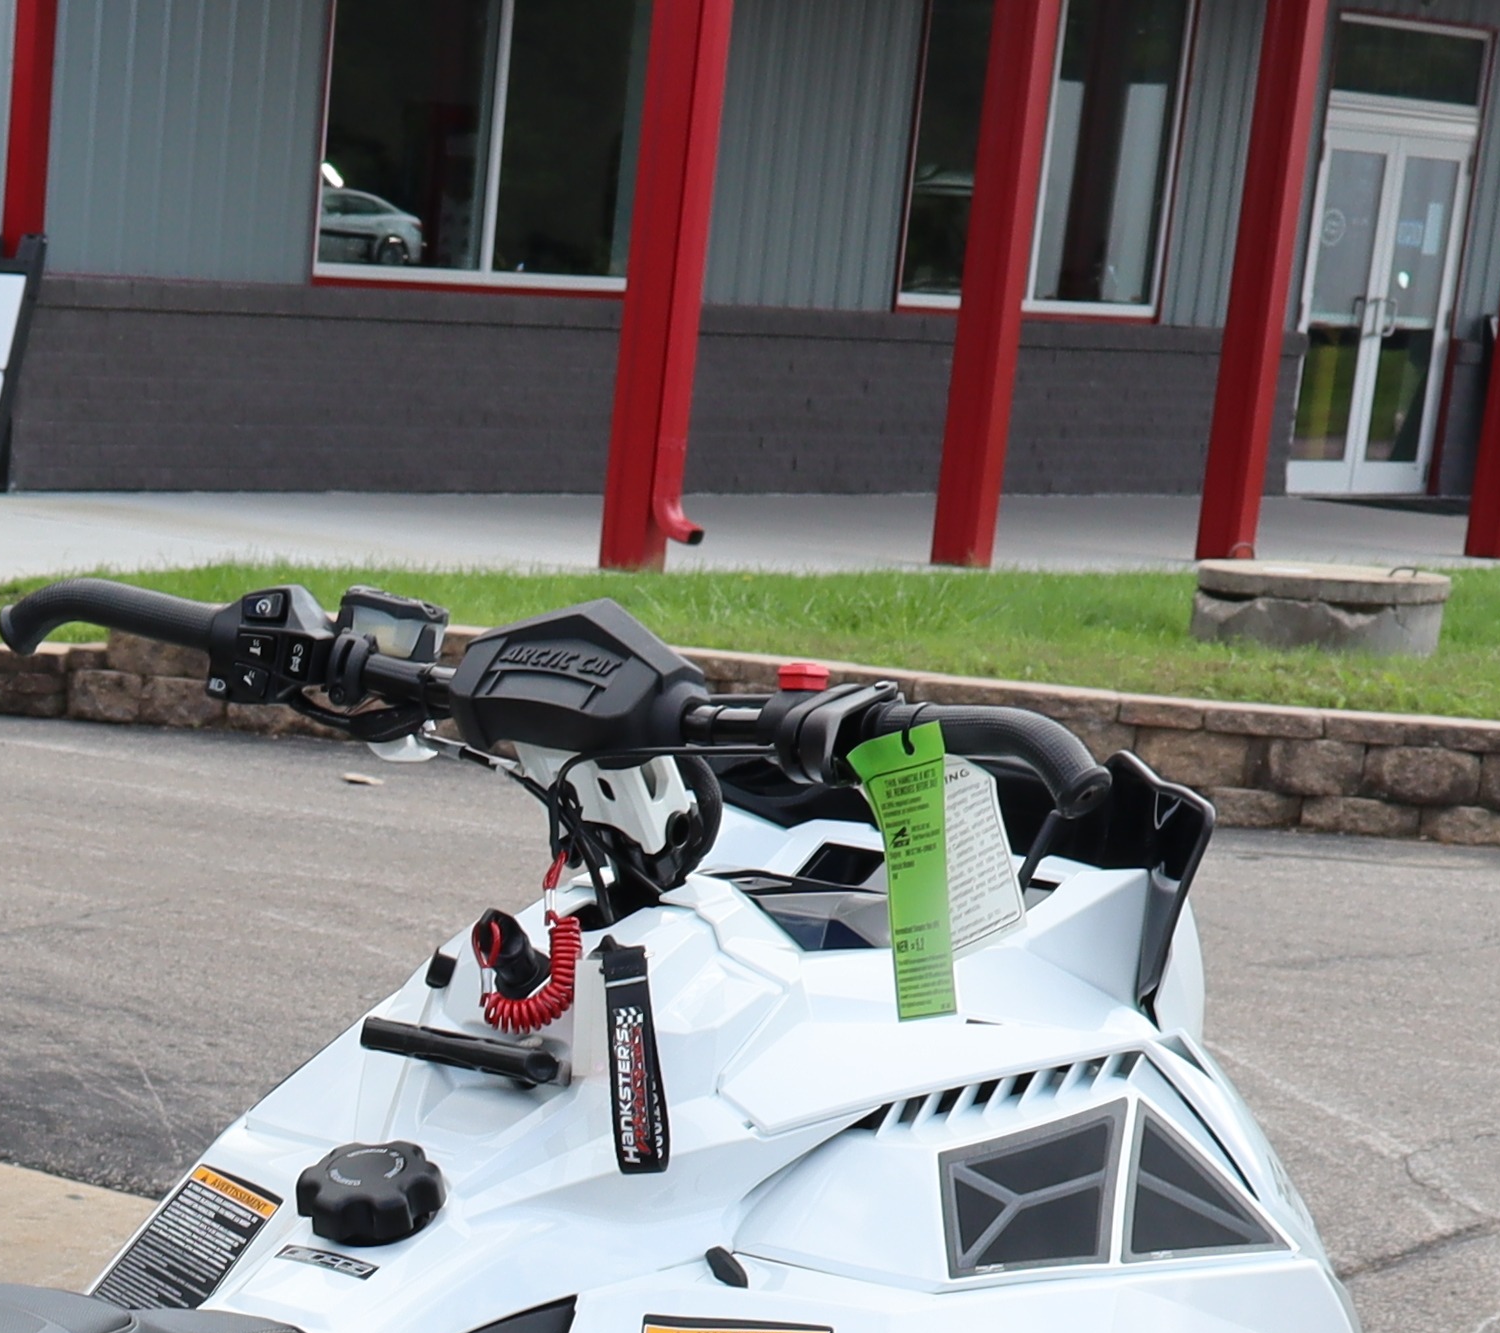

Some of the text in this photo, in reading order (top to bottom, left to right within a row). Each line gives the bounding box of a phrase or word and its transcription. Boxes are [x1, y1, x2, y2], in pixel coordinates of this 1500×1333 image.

[499, 645, 624, 678] ARCTIC CAT
[211, 1177, 267, 1211] AVERTISSEMENT
